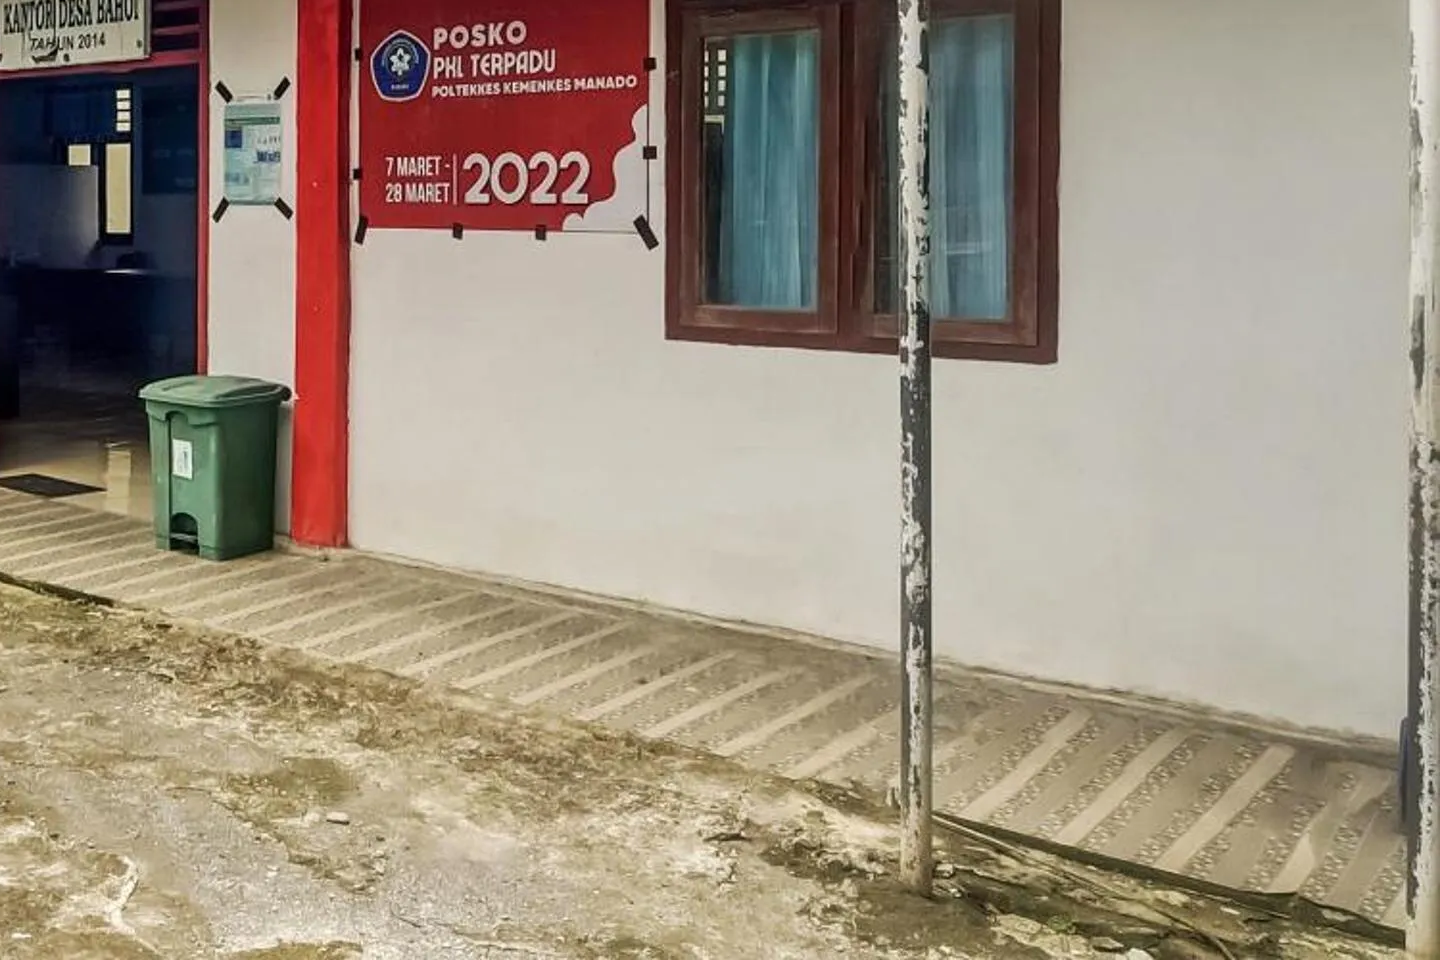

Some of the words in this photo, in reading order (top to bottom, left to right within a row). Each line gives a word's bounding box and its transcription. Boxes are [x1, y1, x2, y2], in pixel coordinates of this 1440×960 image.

[3, 0, 55, 34] KANTOR
[30, 35, 74, 51] TAHUN
[78, 31, 106, 49] 2014
[432, 20, 527, 50] POSKO
[470, 49, 556, 77] TERPADU
[432, 83, 501, 98] POLTEKKES
[503, 78, 571, 95] KEMENKES
[573, 75, 637, 90] MANADO
[385, 156, 394, 177] 7
[396, 155, 442, 176] MARET
[462, 151, 590, 205] 2022
[385, 182, 403, 203] 28
[404, 182, 450, 203] MARET
